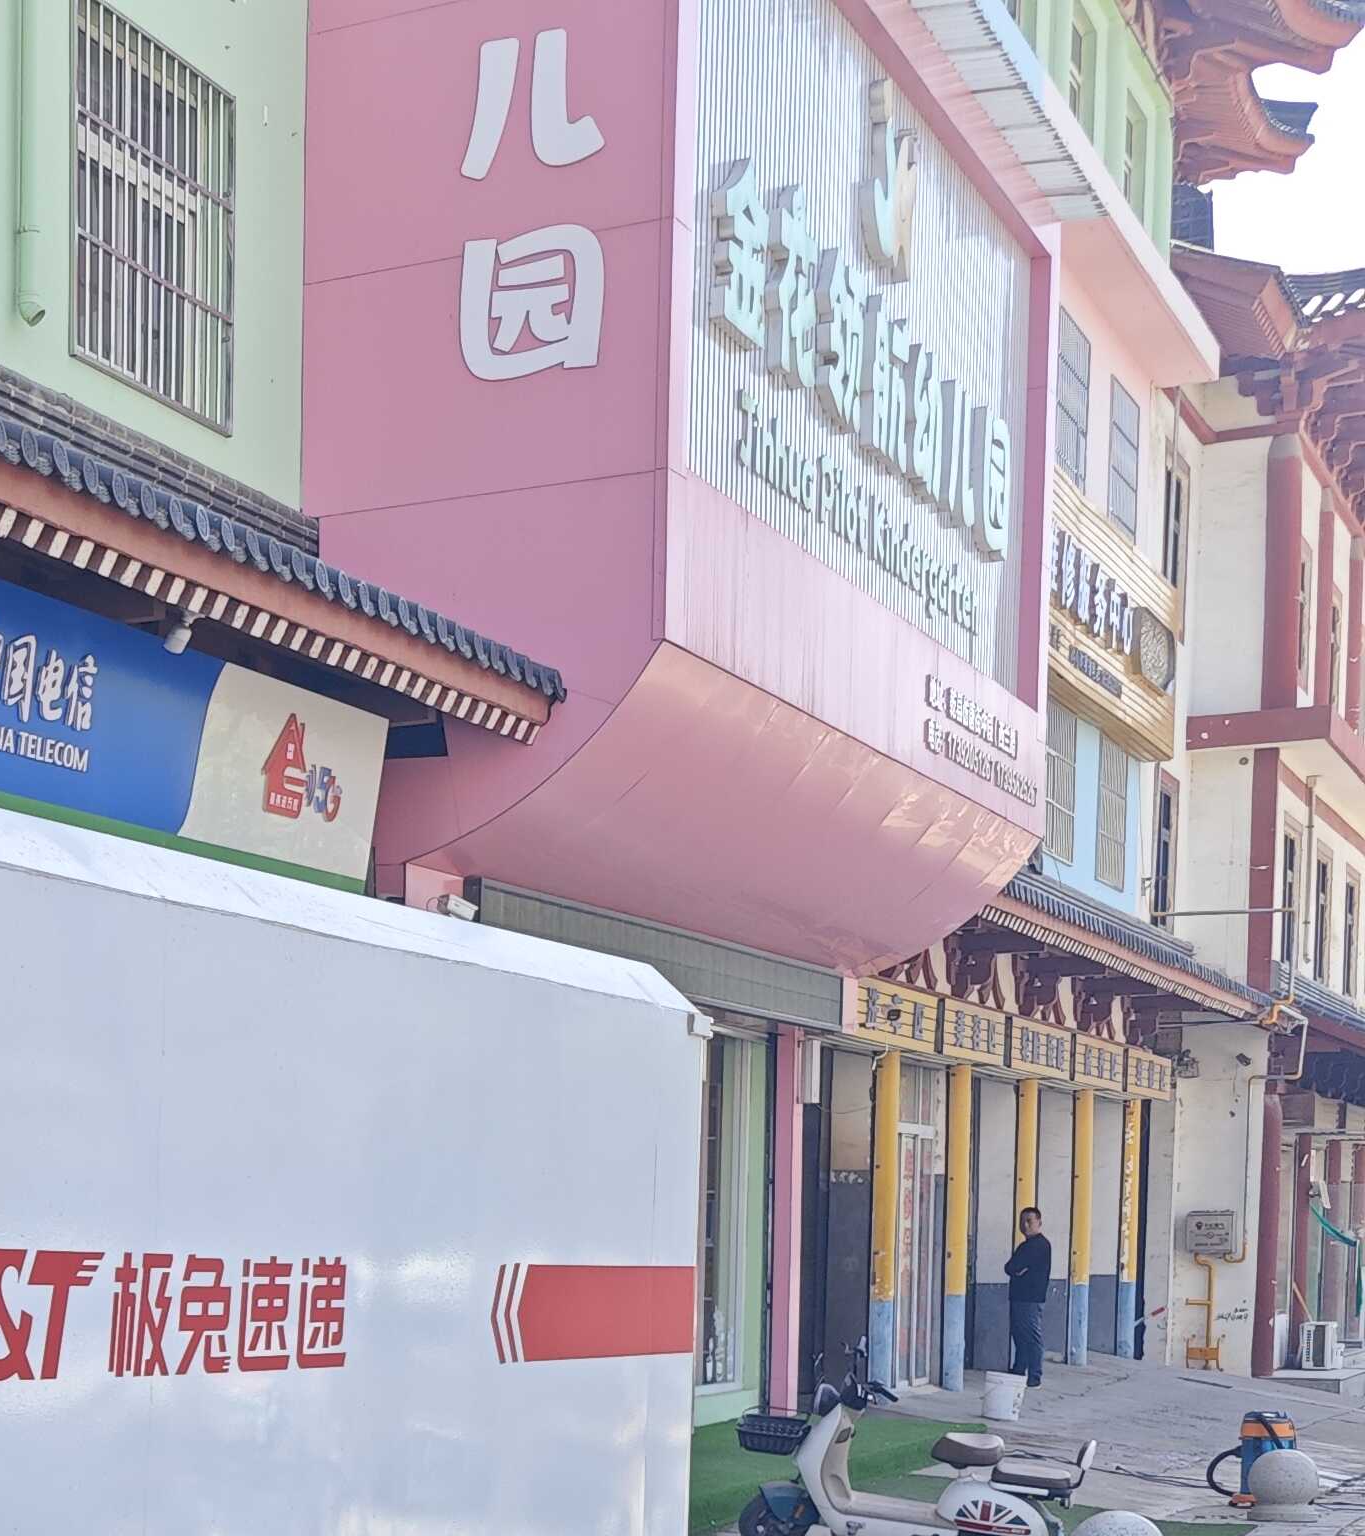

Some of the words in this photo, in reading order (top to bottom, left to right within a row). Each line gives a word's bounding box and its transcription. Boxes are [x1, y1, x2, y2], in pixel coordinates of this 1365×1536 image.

[460, 27, 606, 382] 儿园
[739, 386, 816, 502] Jinhua
[818, 452, 869, 553] Pilot
[19, 730, 90, 772] TELECOM
[107, 1252, 347, 1378] 极兔速递
